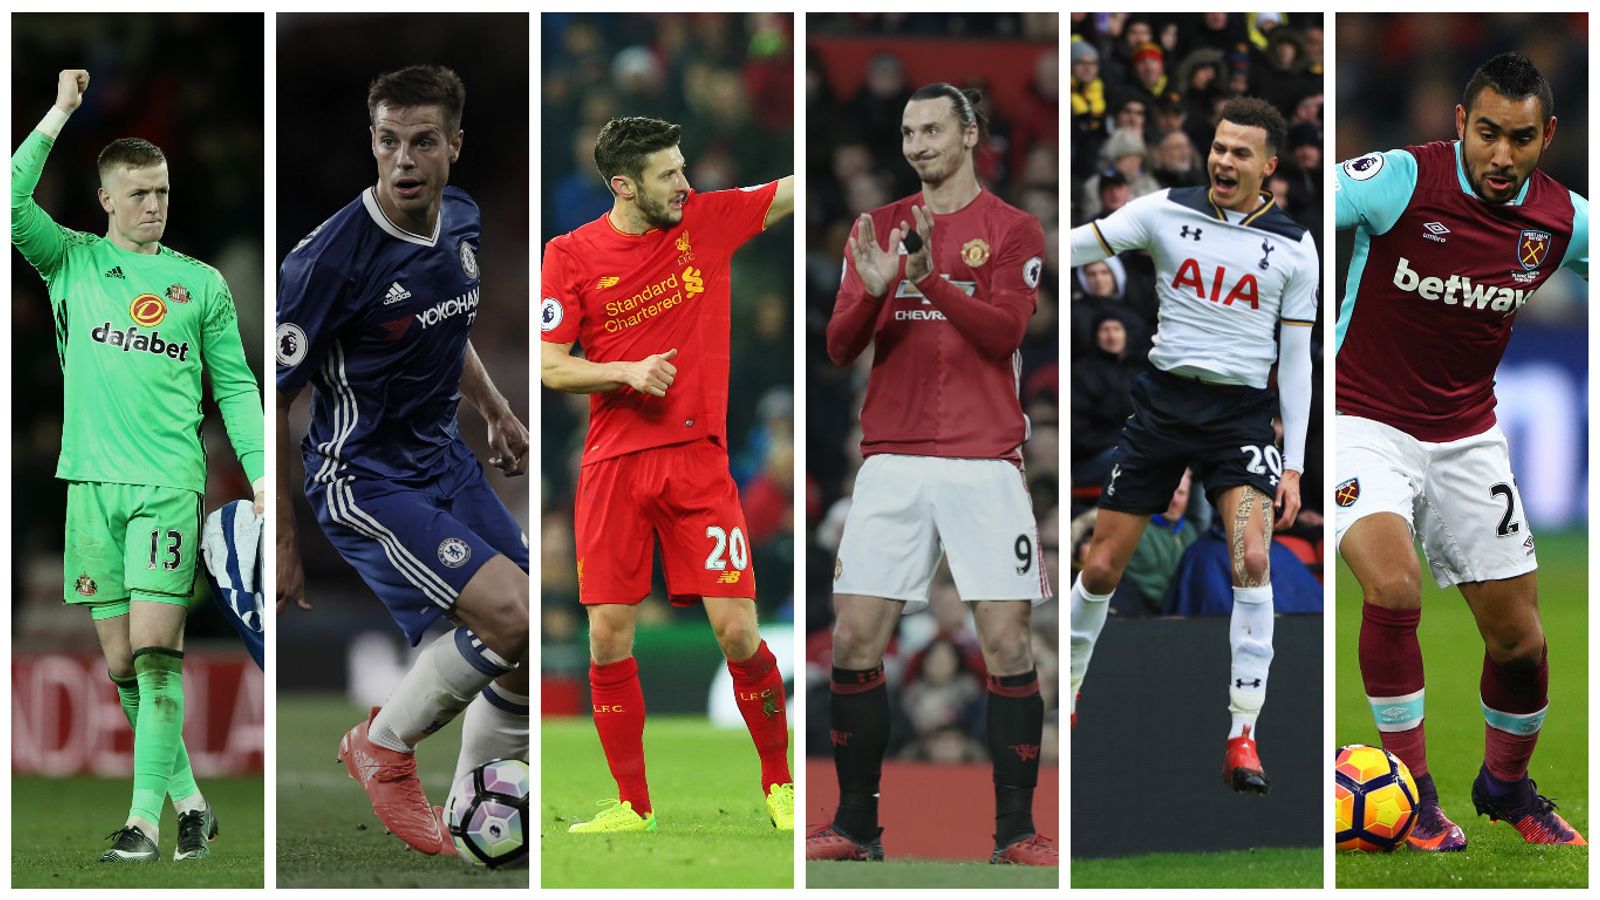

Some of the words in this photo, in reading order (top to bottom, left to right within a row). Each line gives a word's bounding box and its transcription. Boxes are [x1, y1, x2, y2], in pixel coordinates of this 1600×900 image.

[383, 291, 412, 306] adidas
[605, 273, 679, 317] Standard
[1171, 258, 1260, 310] AIA
[1392, 256, 1536, 319] betway
[604, 290, 683, 333] Chartered
[91, 322, 189, 362] dafabet
[1240, 445, 1282, 478] 20
[147, 528, 184, 571] 13
[704, 526, 748, 571] 20
[1014, 534, 1032, 577] 9
